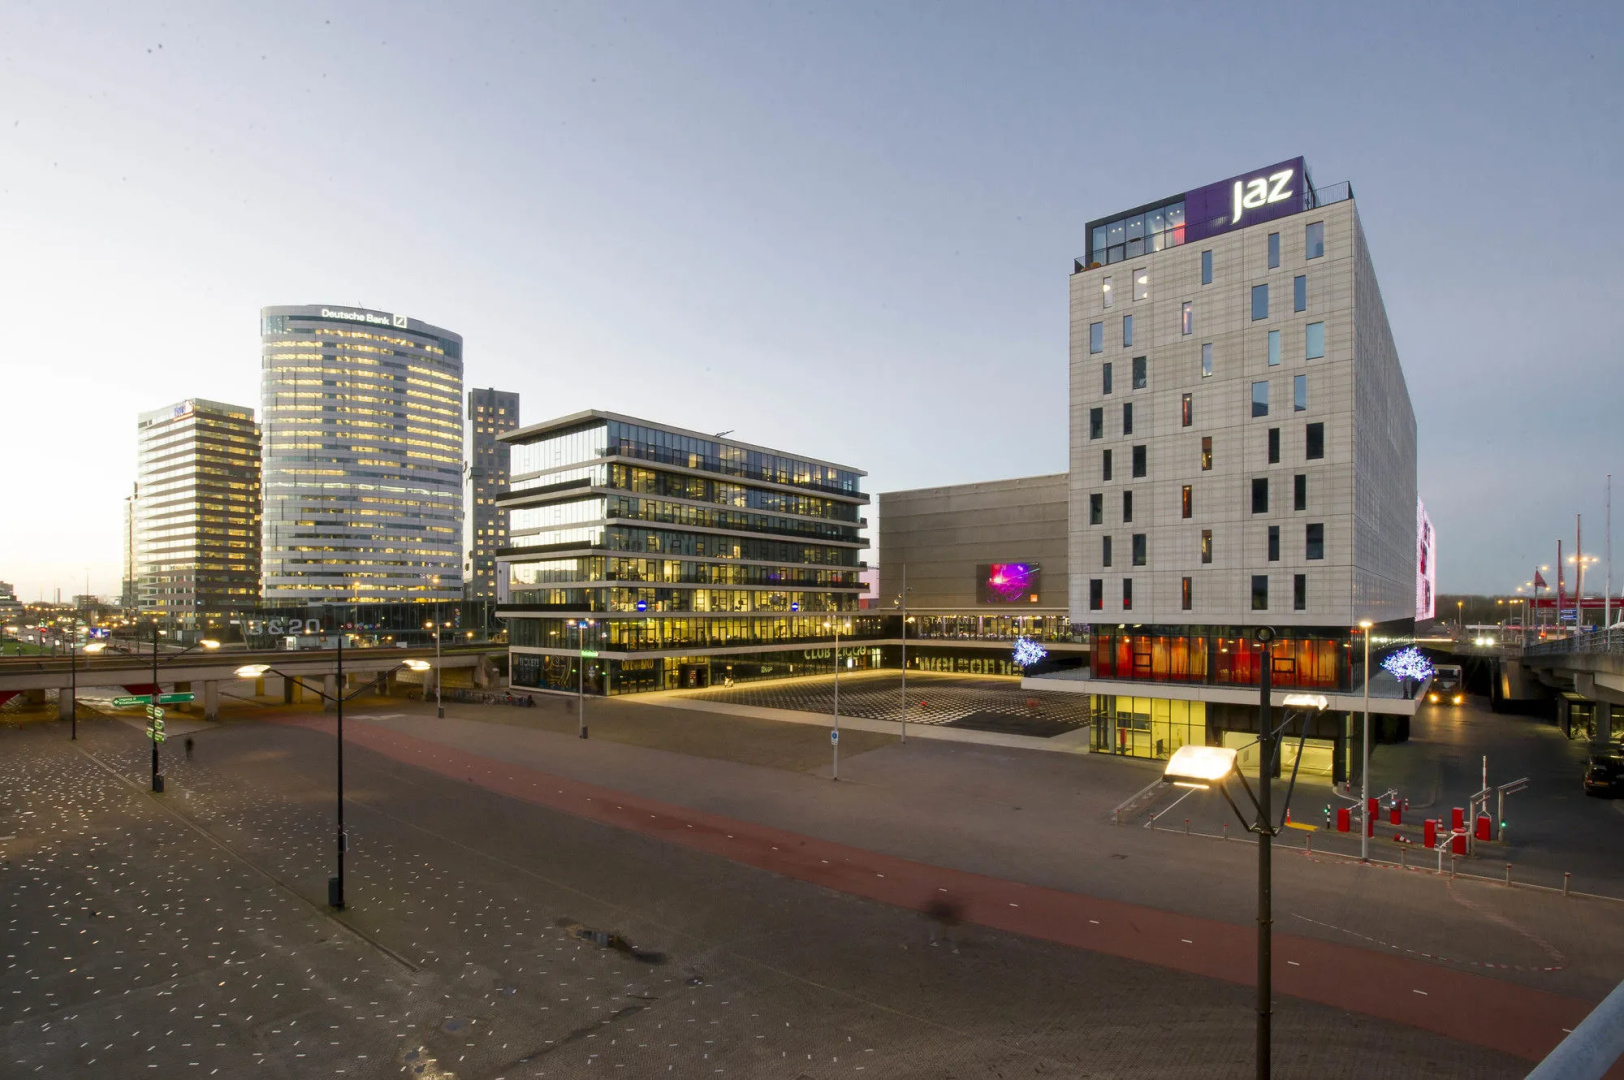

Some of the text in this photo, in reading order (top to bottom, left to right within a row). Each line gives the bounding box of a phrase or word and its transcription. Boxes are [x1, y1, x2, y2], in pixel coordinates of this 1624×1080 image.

[322, 309, 390, 326] Deutsche Bank
[803, 645, 867, 660] CLUB ZIGGO
